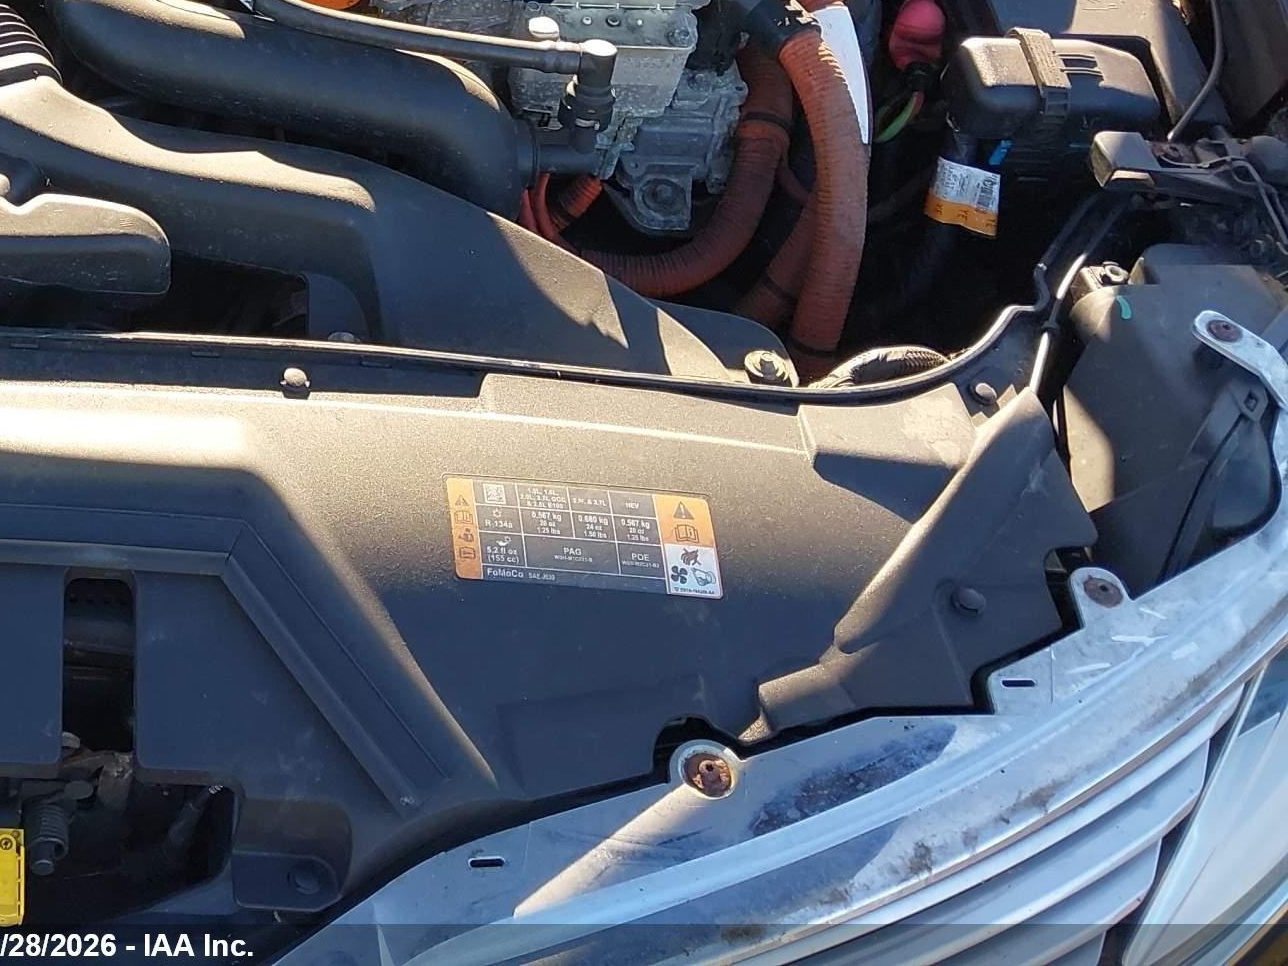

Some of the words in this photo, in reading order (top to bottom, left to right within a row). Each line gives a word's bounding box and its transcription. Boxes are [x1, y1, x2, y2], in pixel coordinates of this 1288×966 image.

[552, 513, 562, 522] kg
[578, 514, 598, 523] 0.680
[599, 516, 609, 526] kg
[586, 523, 594, 531] 24
[641, 520, 650, 529] kg
[537, 526, 550, 534] 1.25
[550, 527, 561, 535] lbs
[597, 531, 608, 539] lbs
[640, 534, 649, 542] lbs
[486, 546, 500, 554] 5.2
[563, 547, 582, 556] PAG
[487, 553, 505, 563] (155
[506, 555, 520, 564] cc)
[631, 552, 650, 562] POE
[487, 567, 524, 578] FoMoCo
